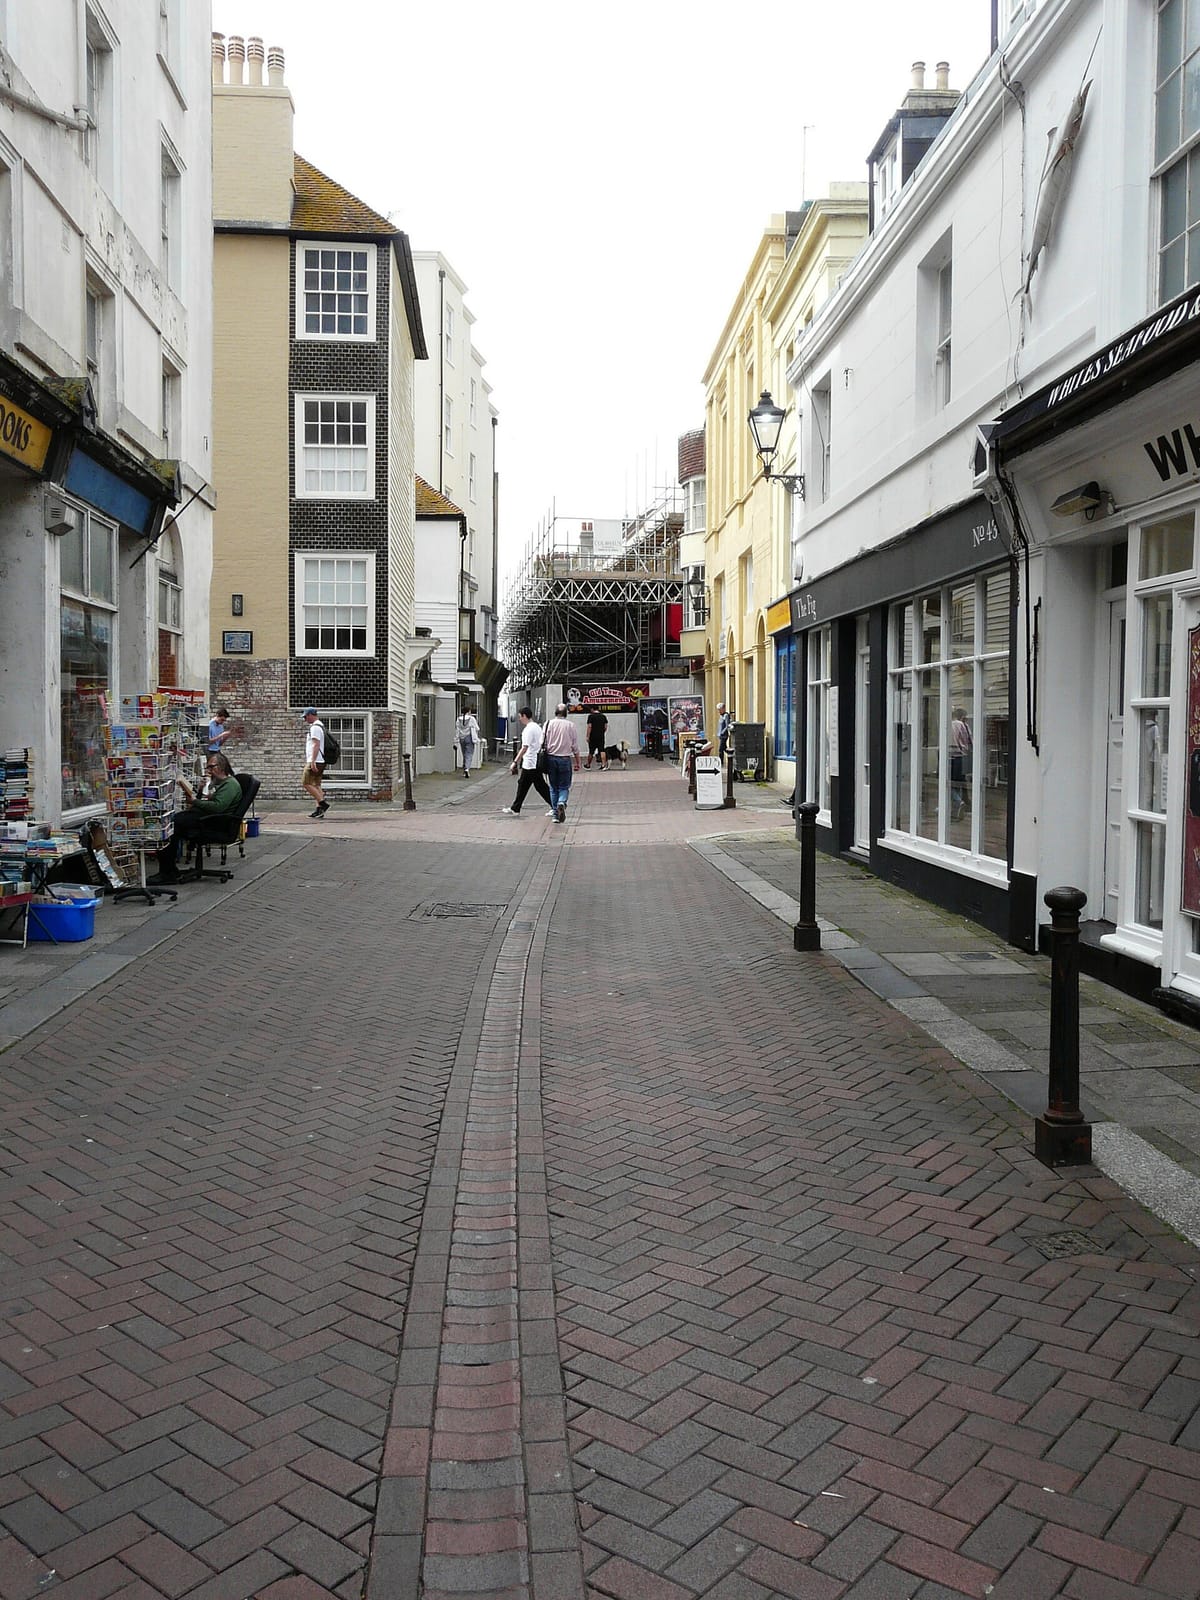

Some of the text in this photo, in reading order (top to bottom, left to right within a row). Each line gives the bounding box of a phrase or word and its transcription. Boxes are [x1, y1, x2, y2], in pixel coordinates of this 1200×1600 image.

[1047, 357, 1104, 408] WHITES
[1103, 301, 1189, 374] SEAFOOD
[796, 598, 807, 618] The
[807, 594, 817, 621] Fig
[583, 695, 630, 704] Amusements
[589, 686, 623, 697] Old Town
